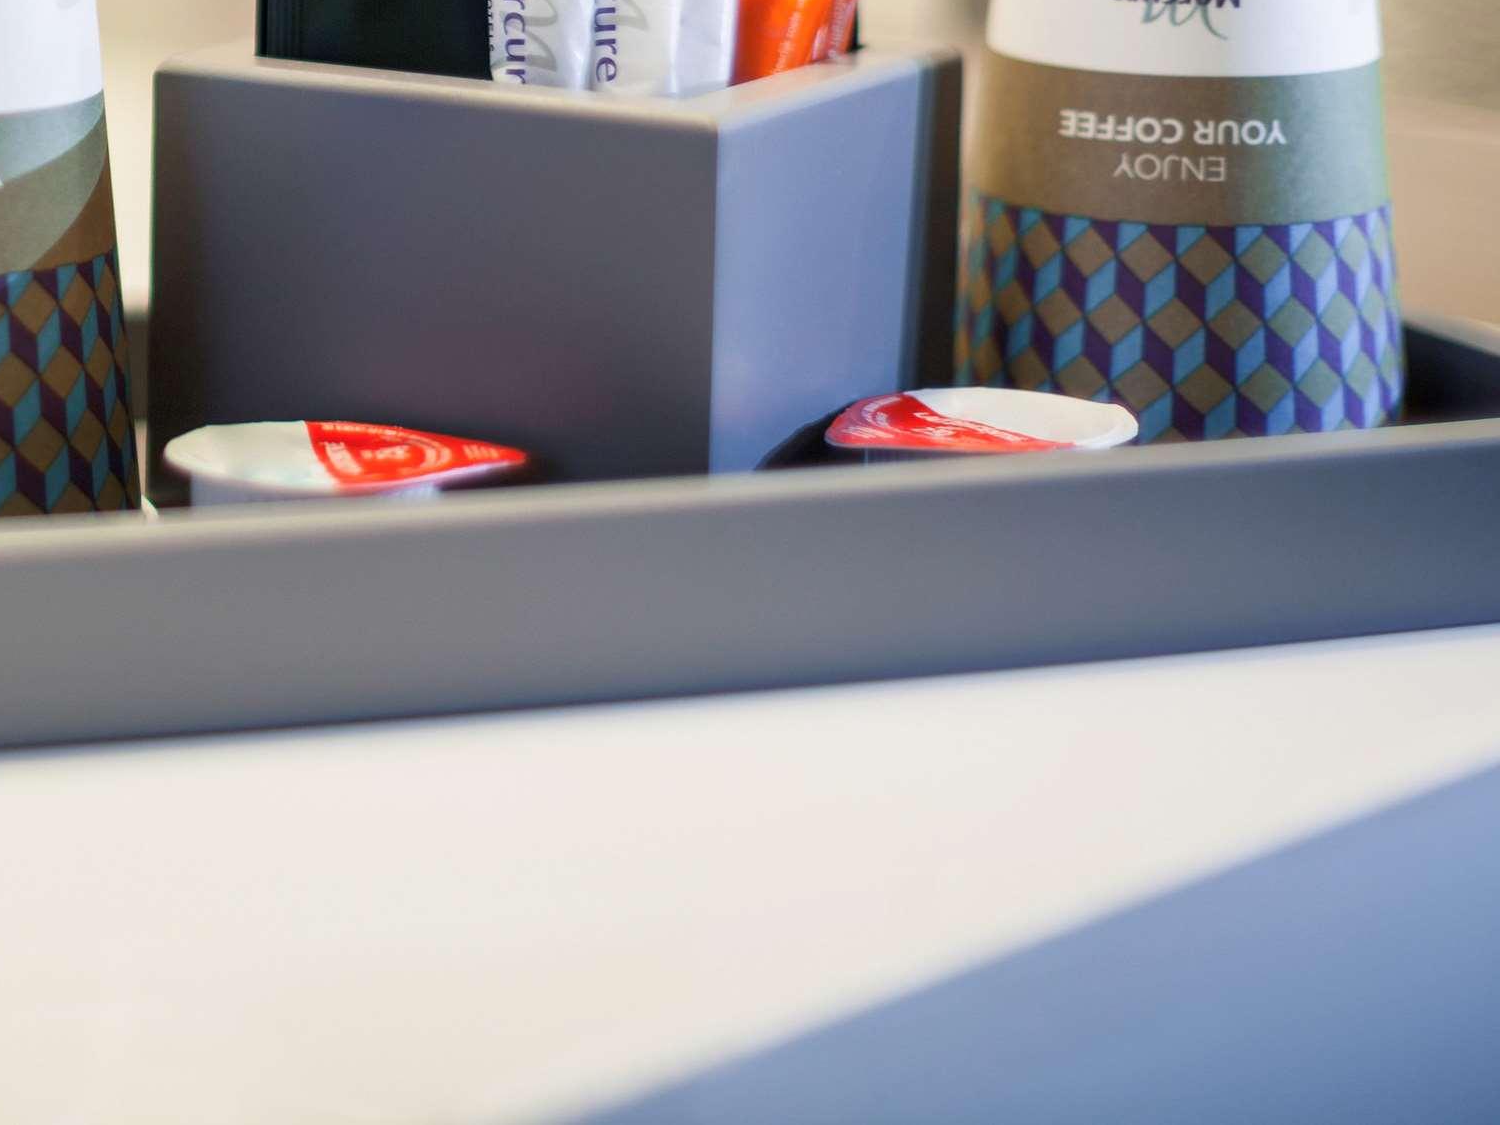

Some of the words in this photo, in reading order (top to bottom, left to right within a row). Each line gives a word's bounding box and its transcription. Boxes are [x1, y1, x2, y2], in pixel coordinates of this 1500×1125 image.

[1058, 109, 1184, 143] COFFEE
[1193, 119, 1287, 146] YOUR
[1113, 153, 1226, 182] ENJOY
